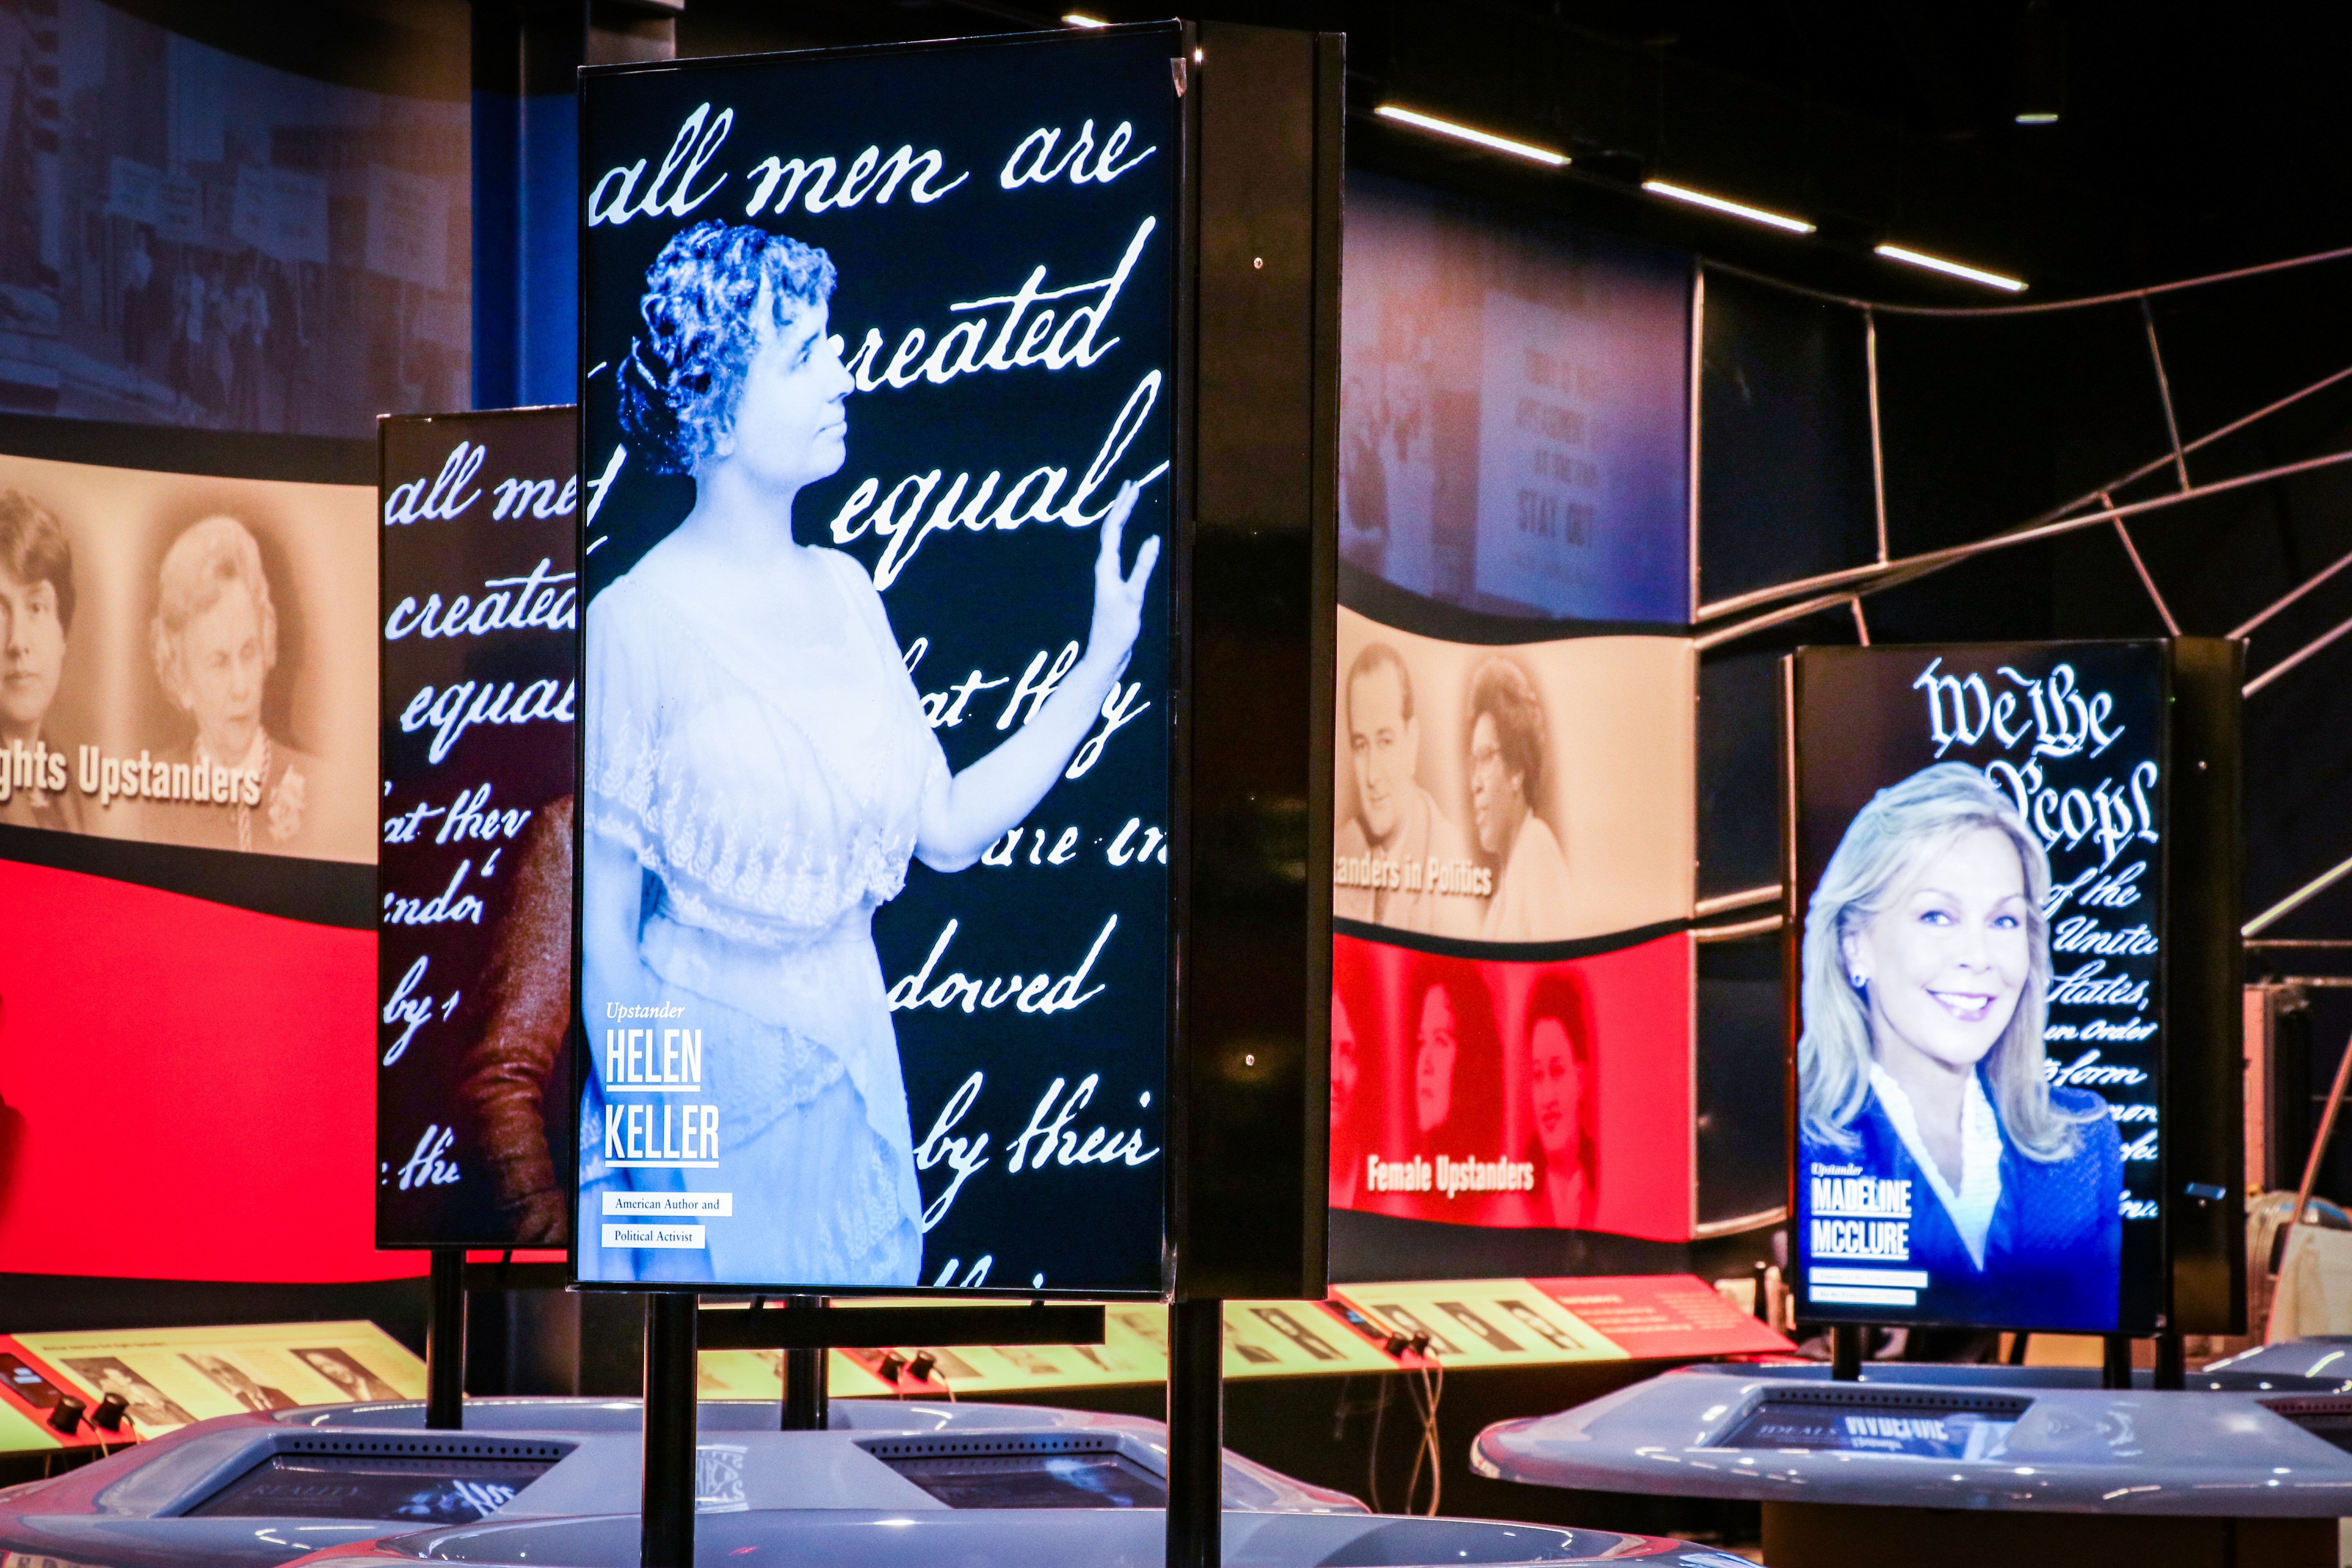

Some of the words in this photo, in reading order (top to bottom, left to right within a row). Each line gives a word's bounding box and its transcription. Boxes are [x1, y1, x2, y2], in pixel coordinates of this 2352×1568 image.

[588, 102, 734, 226] all
[746, 143, 969, 217] men
[1000, 118, 1157, 191] are
[385, 441, 486, 525] all
[829, 369, 1170, 591] equal
[79, 744, 261, 805] Upstanders
[1334, 851, 1400, 890] anders
[1405, 855, 1422, 889] in
[1428, 856, 1492, 895] Politics
[2078, 860, 2147, 907] the
[383, 955, 433, 1065] by
[606, 1001, 686, 1023] Upstander
[605, 1029, 702, 1083] HELEN
[2053, 1049, 2148, 1087] form
[604, 1104, 719, 1159] KELLER
[915, 1072, 990, 1234] by
[1007, 1073, 1161, 1174] their
[1367, 1154, 1432, 1192] Female
[1436, 1154, 1535, 1200] Upstanders
[1811, 1162, 1863, 1177] Upstander
[615, 1198, 661, 1210] American
[664, 1198, 699, 1210] Author
[701, 1198, 720, 1210] and
[1811, 1177, 1912, 1213] MADELINE
[614, 1230, 653, 1242] Political
[655, 1230, 693, 1243] Activist
[1811, 1219, 1910, 1255] MCCLURE
